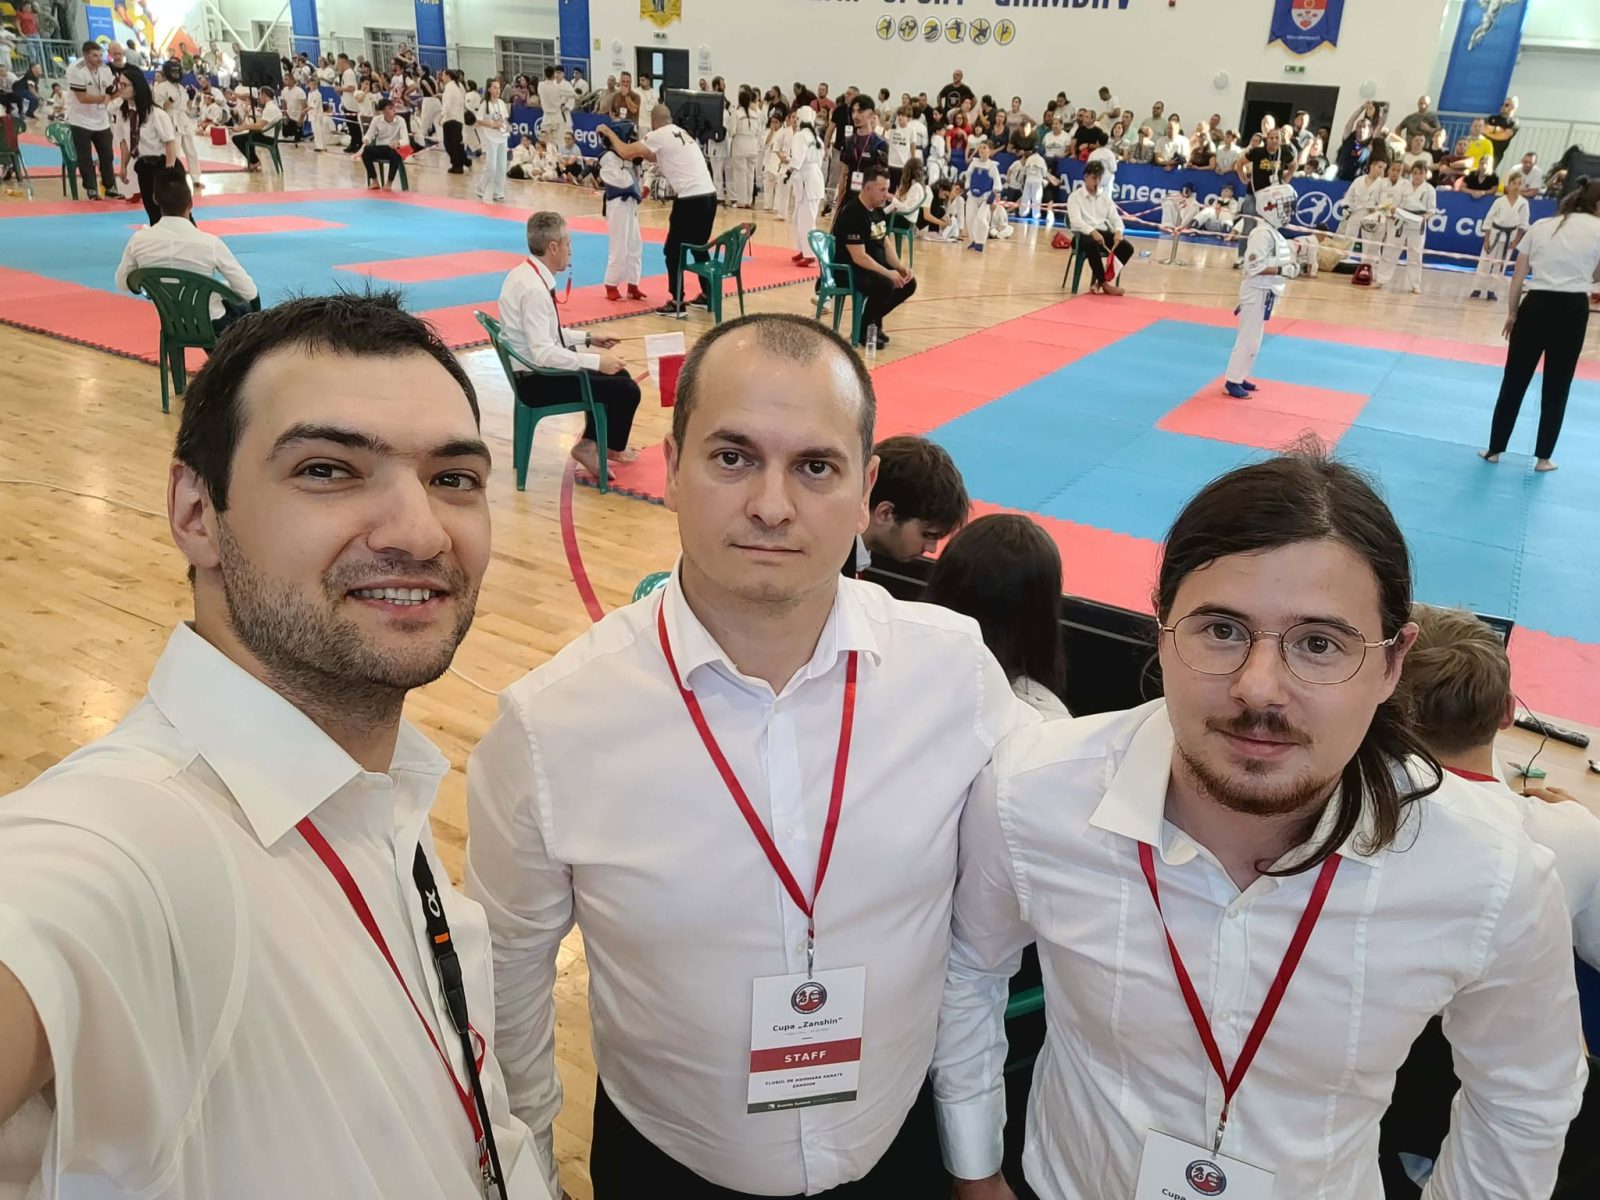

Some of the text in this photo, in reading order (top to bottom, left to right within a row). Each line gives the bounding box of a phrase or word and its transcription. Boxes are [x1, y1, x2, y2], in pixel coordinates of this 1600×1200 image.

[772, 1024, 795, 1032] Cupa
[784, 1050, 827, 1063] STAFF
[1161, 1188, 1187, 1200] Cupa
